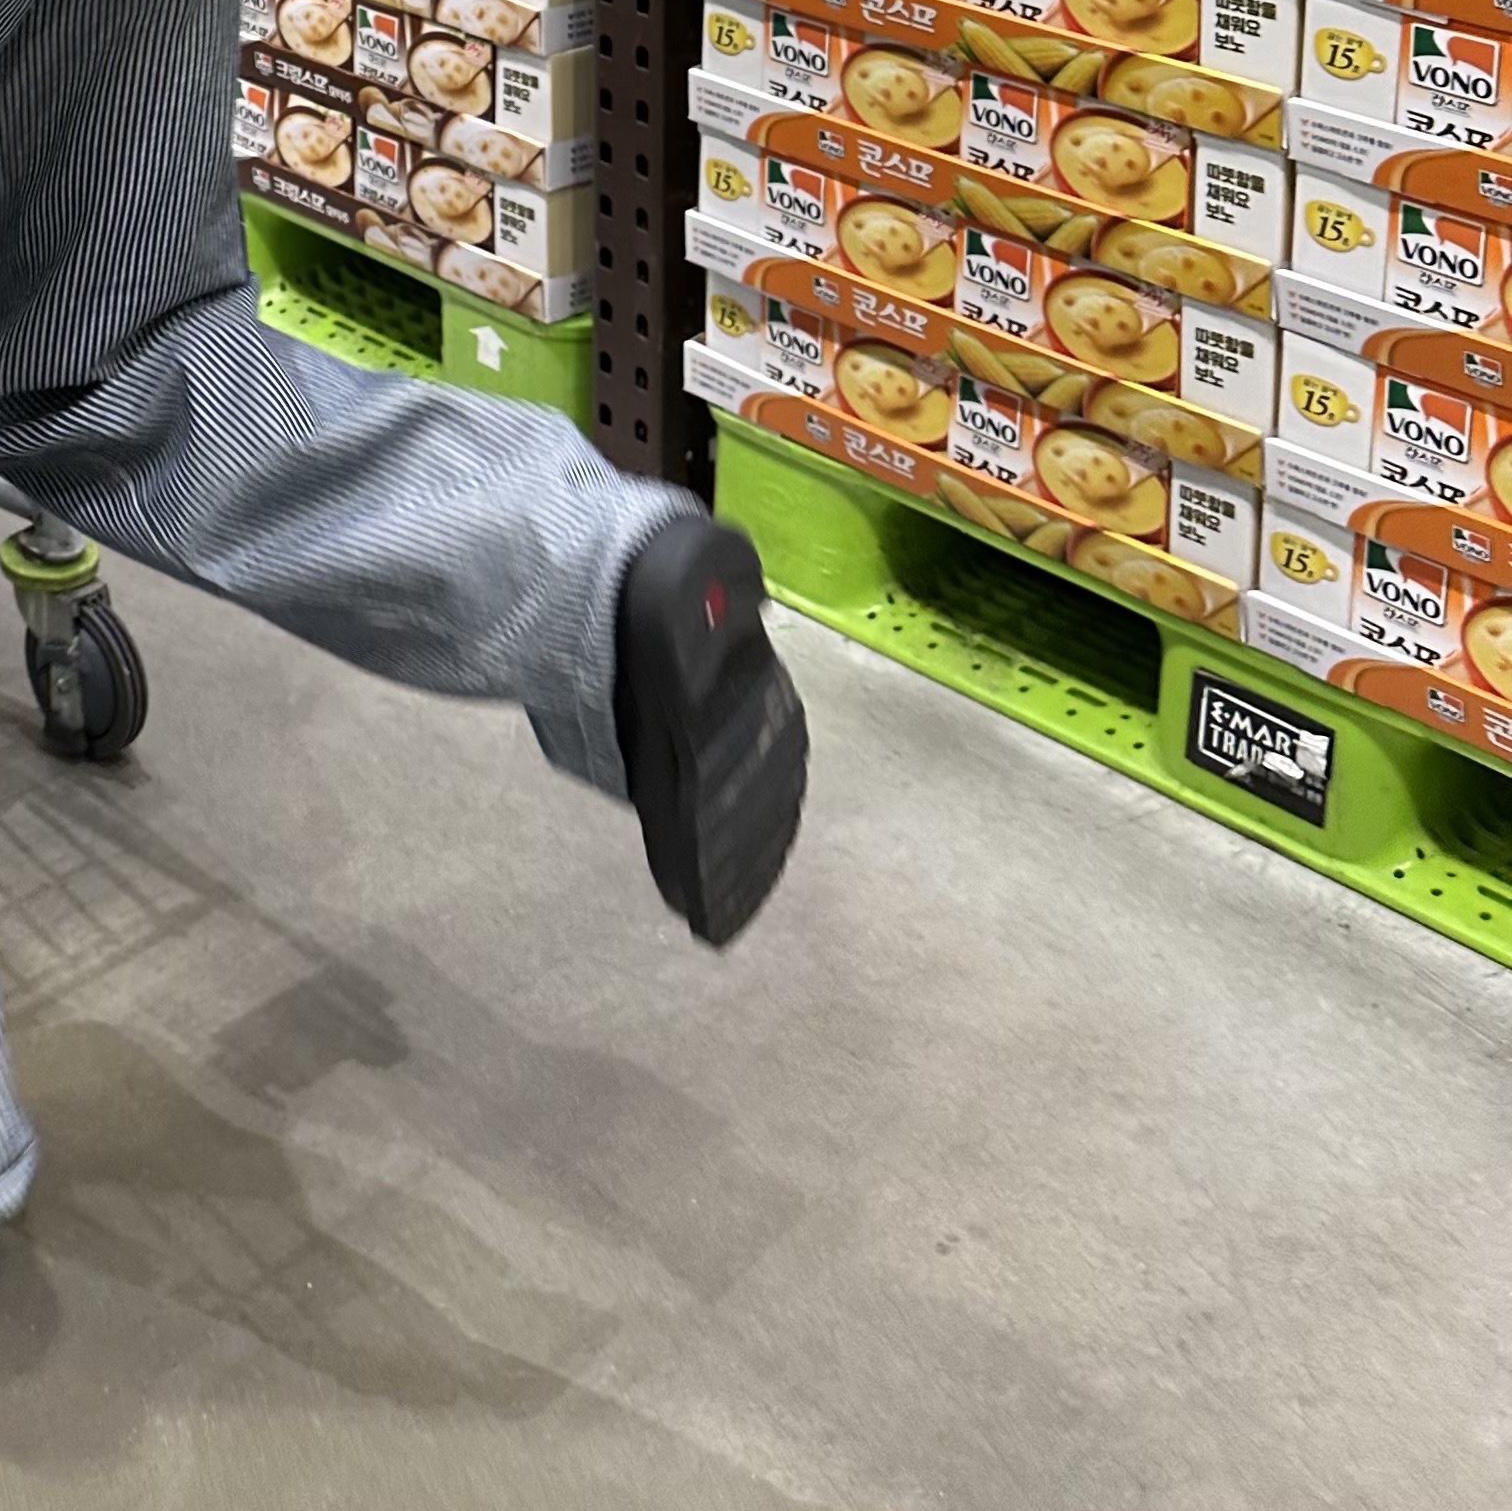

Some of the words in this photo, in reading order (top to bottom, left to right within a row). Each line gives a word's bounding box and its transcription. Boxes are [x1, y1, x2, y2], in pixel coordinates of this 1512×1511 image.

[358, 31, 396, 59] VONO
[769, 41, 828, 73] VONO
[1412, 60, 1493, 100] VONO
[972, 106, 1036, 137] VONO
[857, 138, 934, 188] 콘스프
[767, 188, 824, 219] VONO
[963, 259, 1027, 294] VONO
[1401, 237, 1480, 280] VONO
[852, 288, 928, 338] 콘스프
[767, 324, 821, 360] VONO
[958, 407, 1019, 444] VONO
[1387, 411, 1466, 456] VONO
[1365, 573, 1441, 620] VONO
